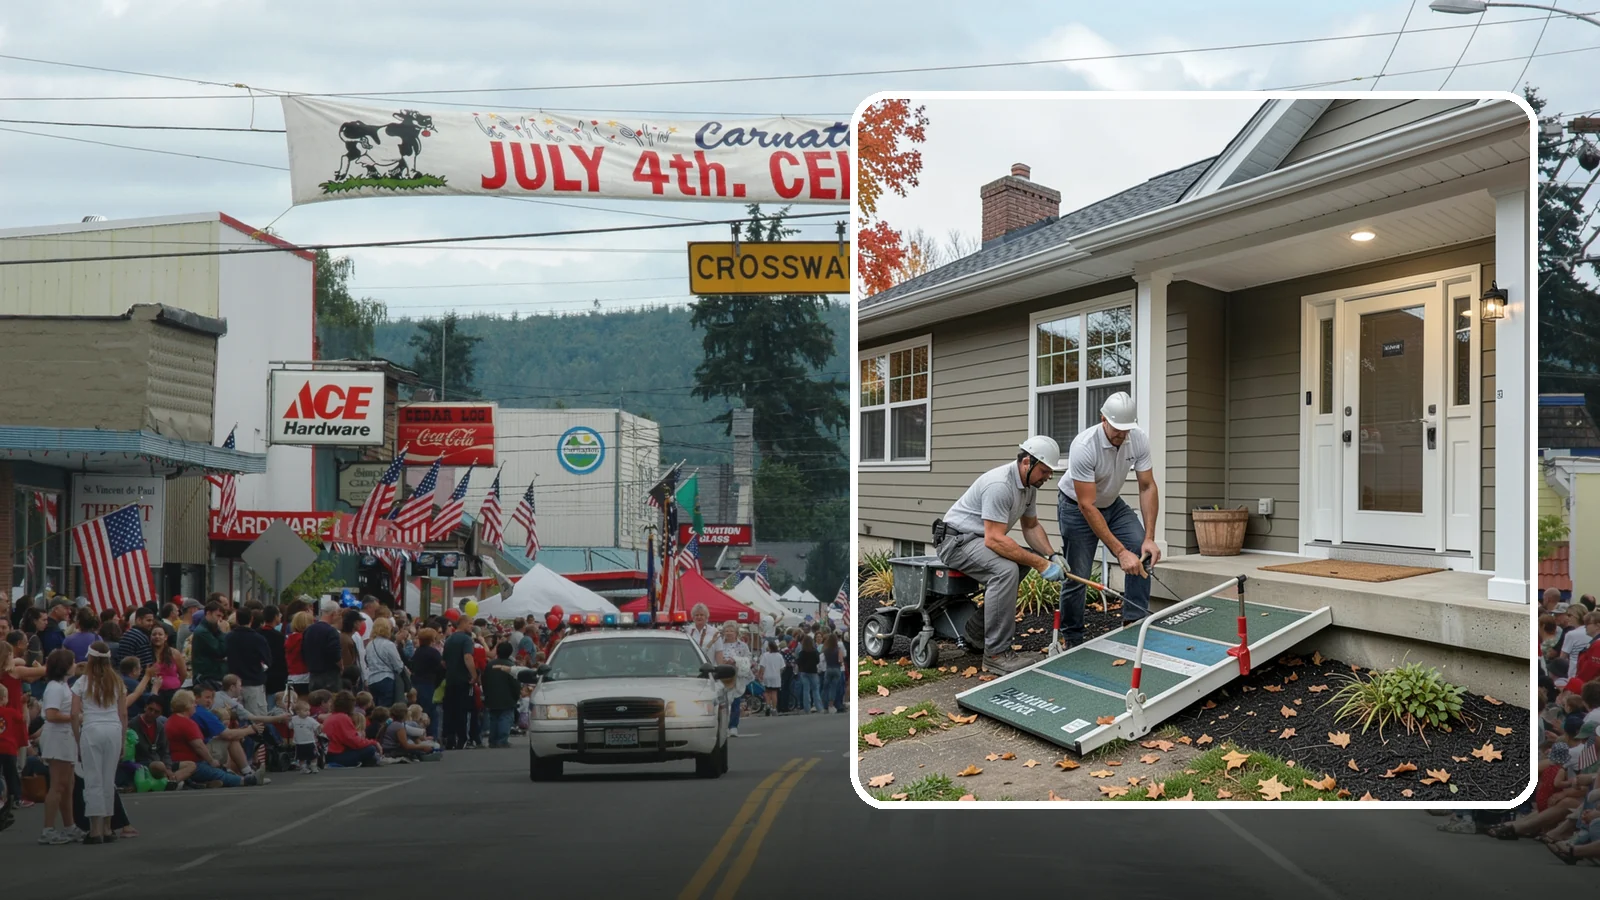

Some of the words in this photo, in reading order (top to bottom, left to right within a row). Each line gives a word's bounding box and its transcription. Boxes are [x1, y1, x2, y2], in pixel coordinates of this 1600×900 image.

[481, 140, 604, 192] JULY
[632, 149, 746, 198] 4th.
[697, 254, 850, 280] CROSSWA
[283, 380, 373, 420] ACE
[406, 409, 452, 423] CEDAR
[461, 409, 485, 422] LOG
[283, 421, 371, 437] Hardware
[354, 467, 384, 481] Simpl
[95, 485, 124, 495] Vincent
[126, 486, 136, 495] de
[137, 486, 155, 496] Paul
[81, 503, 154, 522] THT
[212, 516, 331, 536] HARDARE
[688, 526, 741, 535] CRNATION
[699, 535, 730, 543] GLASS
